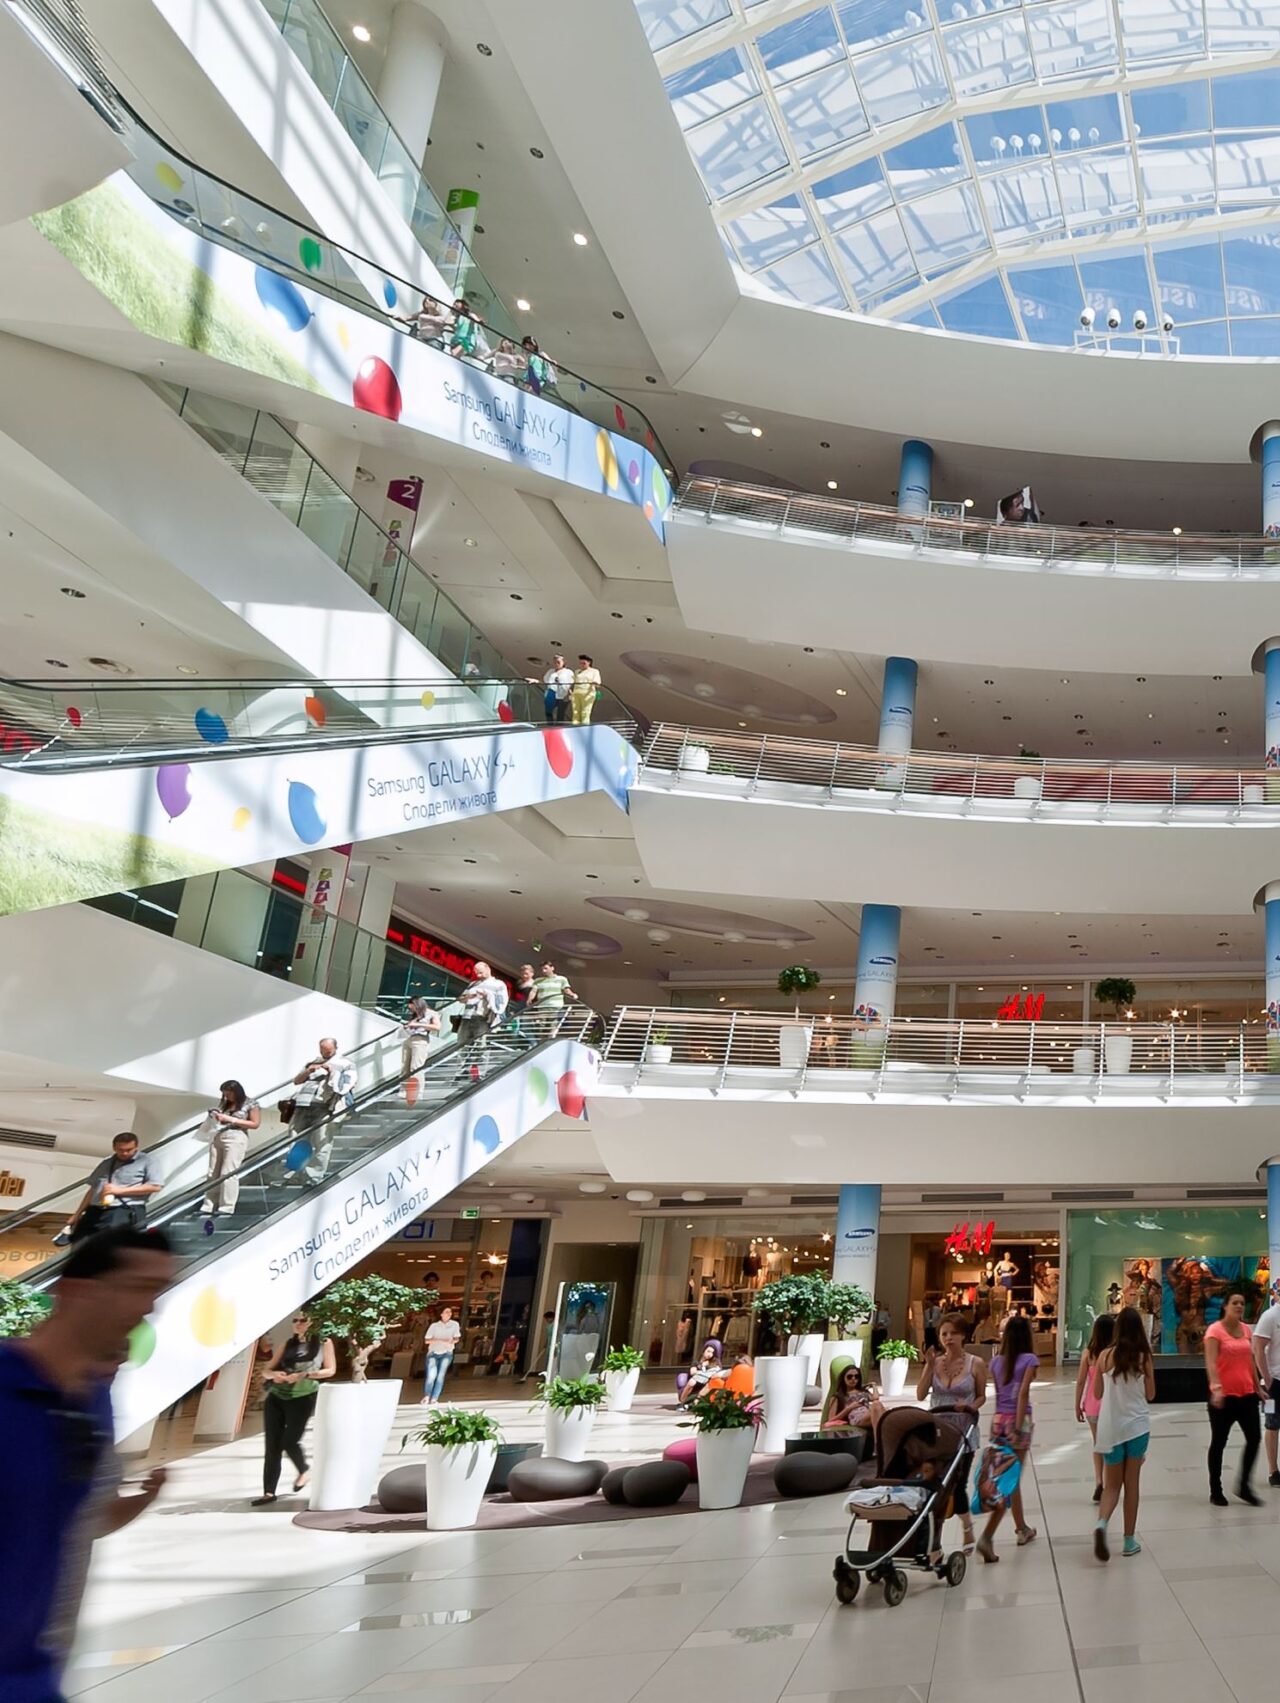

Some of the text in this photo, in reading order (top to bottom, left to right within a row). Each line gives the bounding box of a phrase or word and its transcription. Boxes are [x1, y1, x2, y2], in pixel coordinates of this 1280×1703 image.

[443, 381, 491, 420] Samsung
[493, 396, 547, 439] GALAXY
[401, 484, 415, 499] 2
[367, 775, 425, 797] Samsung
[428, 755, 491, 787] GALAXY
[403, 791, 498, 821] Сподели живота
[997, 992, 1046, 1021] H&M
[269, 1221, 341, 1281] Samsung
[344, 1152, 421, 1225] GALAXY
[313, 1225, 380, 1281] Сподели
[944, 1220, 995, 1254] H&M
